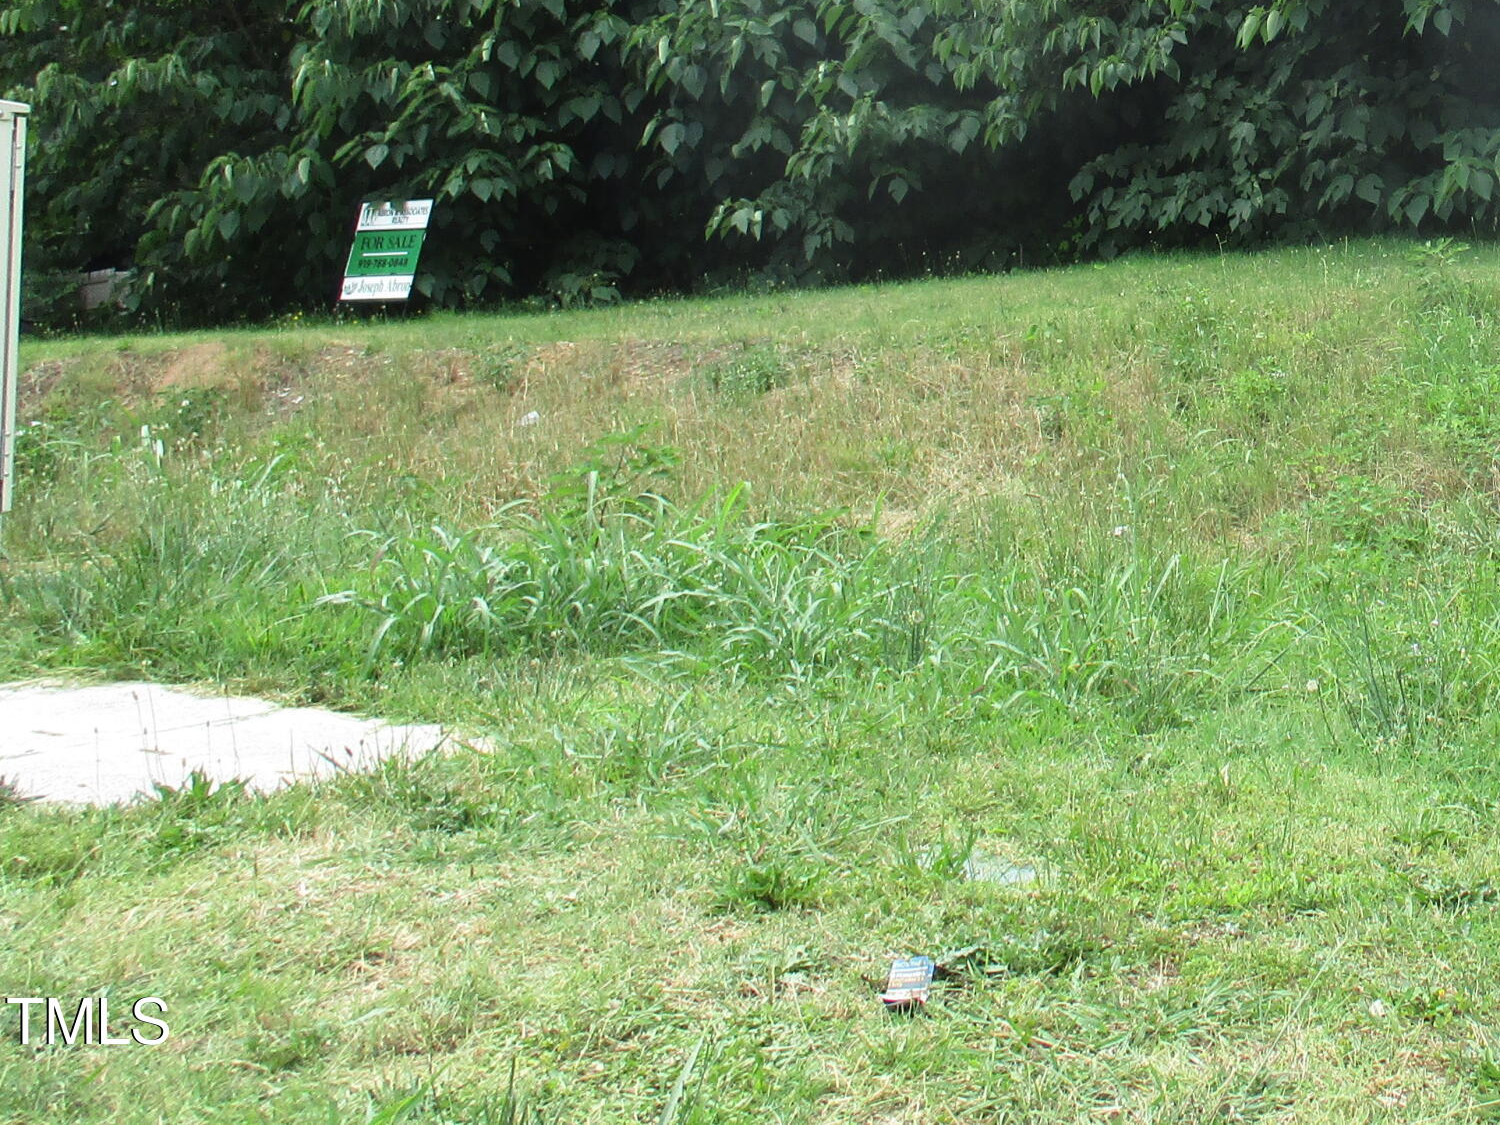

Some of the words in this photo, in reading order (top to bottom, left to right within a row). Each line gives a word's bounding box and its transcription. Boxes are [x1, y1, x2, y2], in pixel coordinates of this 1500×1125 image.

[360, 236, 384, 251] FOR
[388, 234, 416, 249] SALE
[357, 279, 384, 296] Joseph
